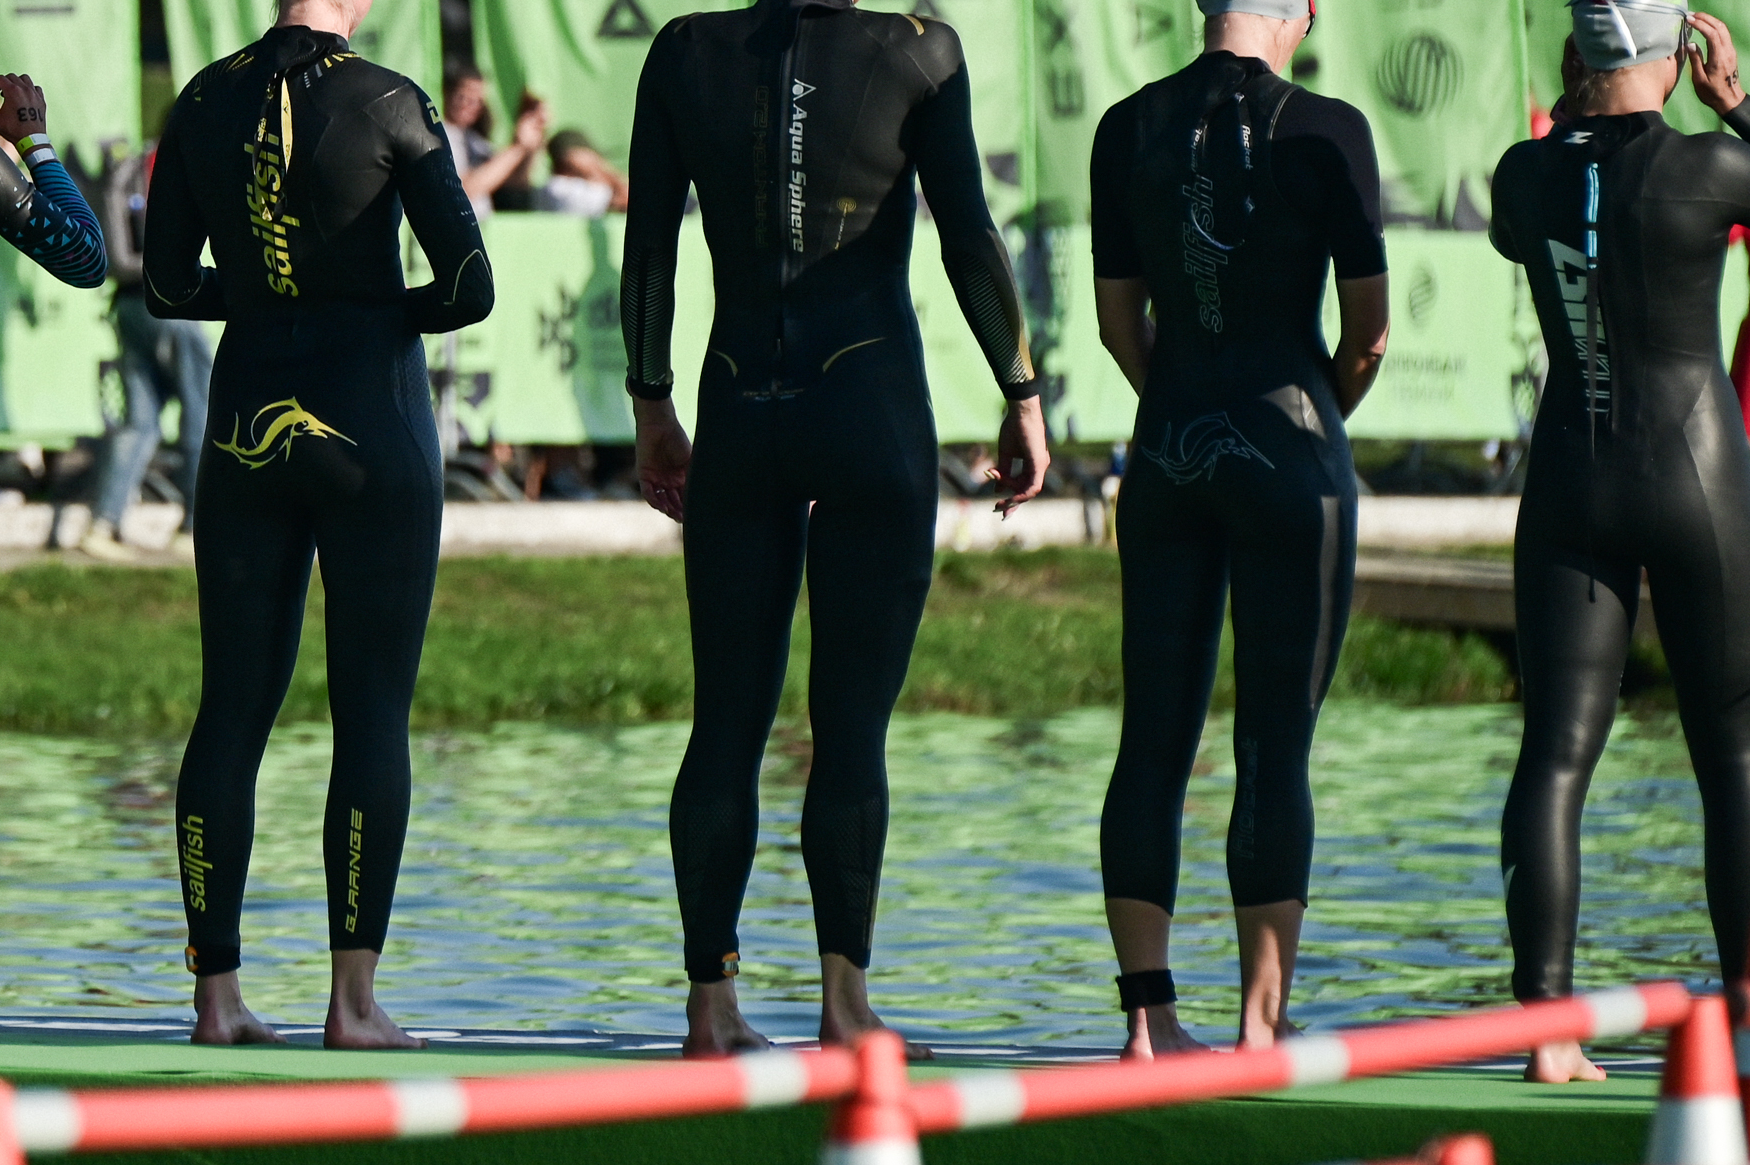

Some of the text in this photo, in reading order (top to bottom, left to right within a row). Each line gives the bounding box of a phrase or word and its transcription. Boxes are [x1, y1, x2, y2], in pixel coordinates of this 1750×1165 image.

[17, 107, 43, 123] 163
[788, 103, 808, 253] Aqua Sphere
[182, 814, 213, 913] sailfish
